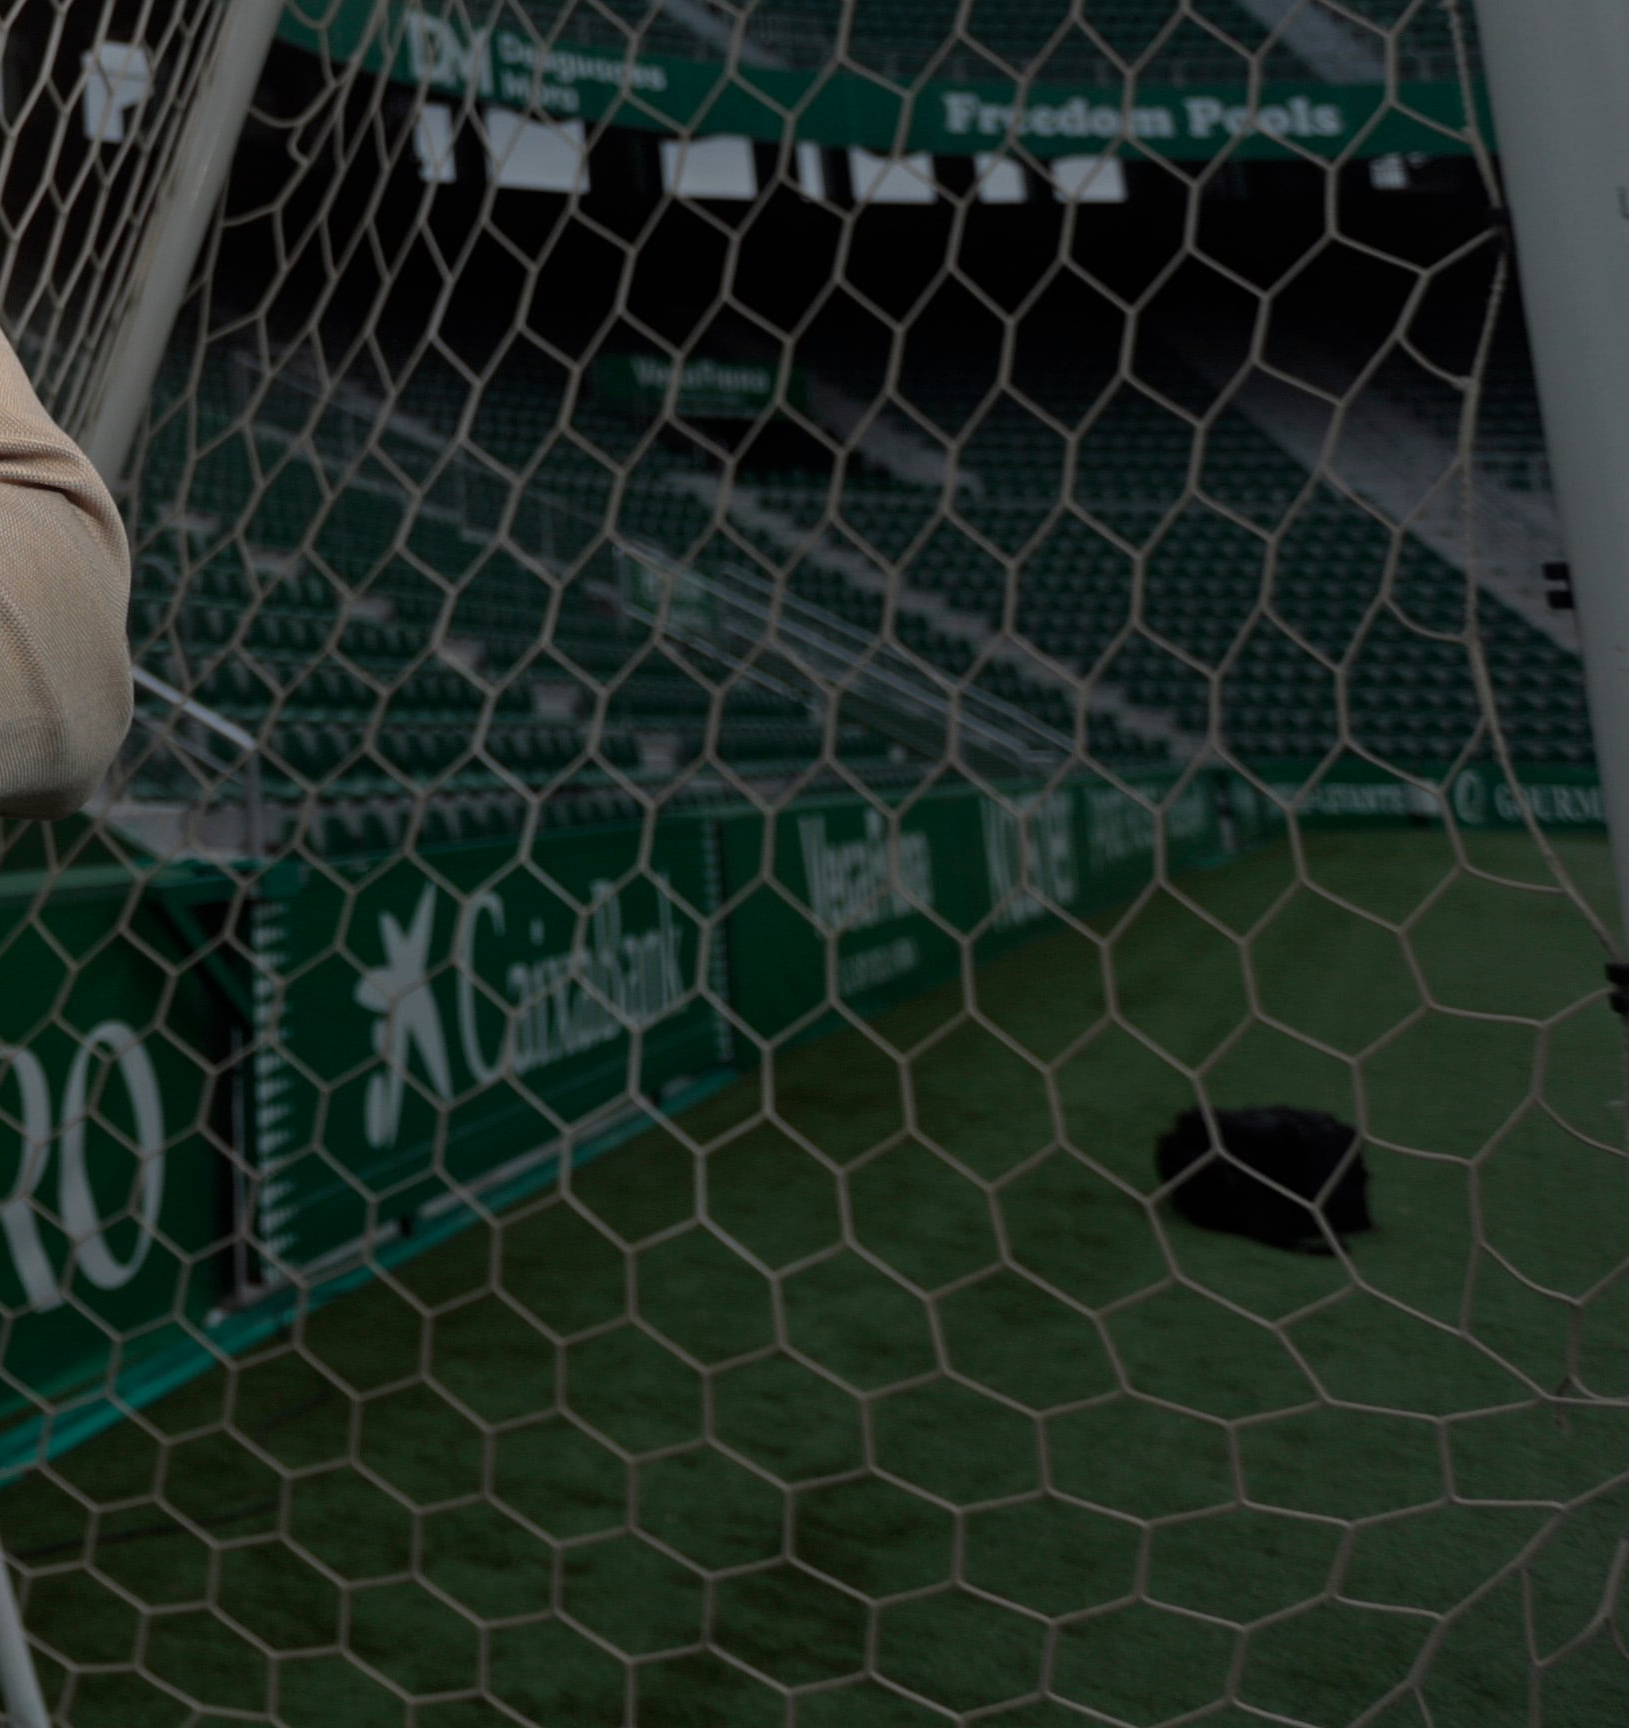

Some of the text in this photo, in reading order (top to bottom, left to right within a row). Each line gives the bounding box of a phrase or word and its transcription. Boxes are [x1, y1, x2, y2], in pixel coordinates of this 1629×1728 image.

[944, 90, 1345, 140] Freedom Pools
[454, 872, 687, 1085] CaixaBank
